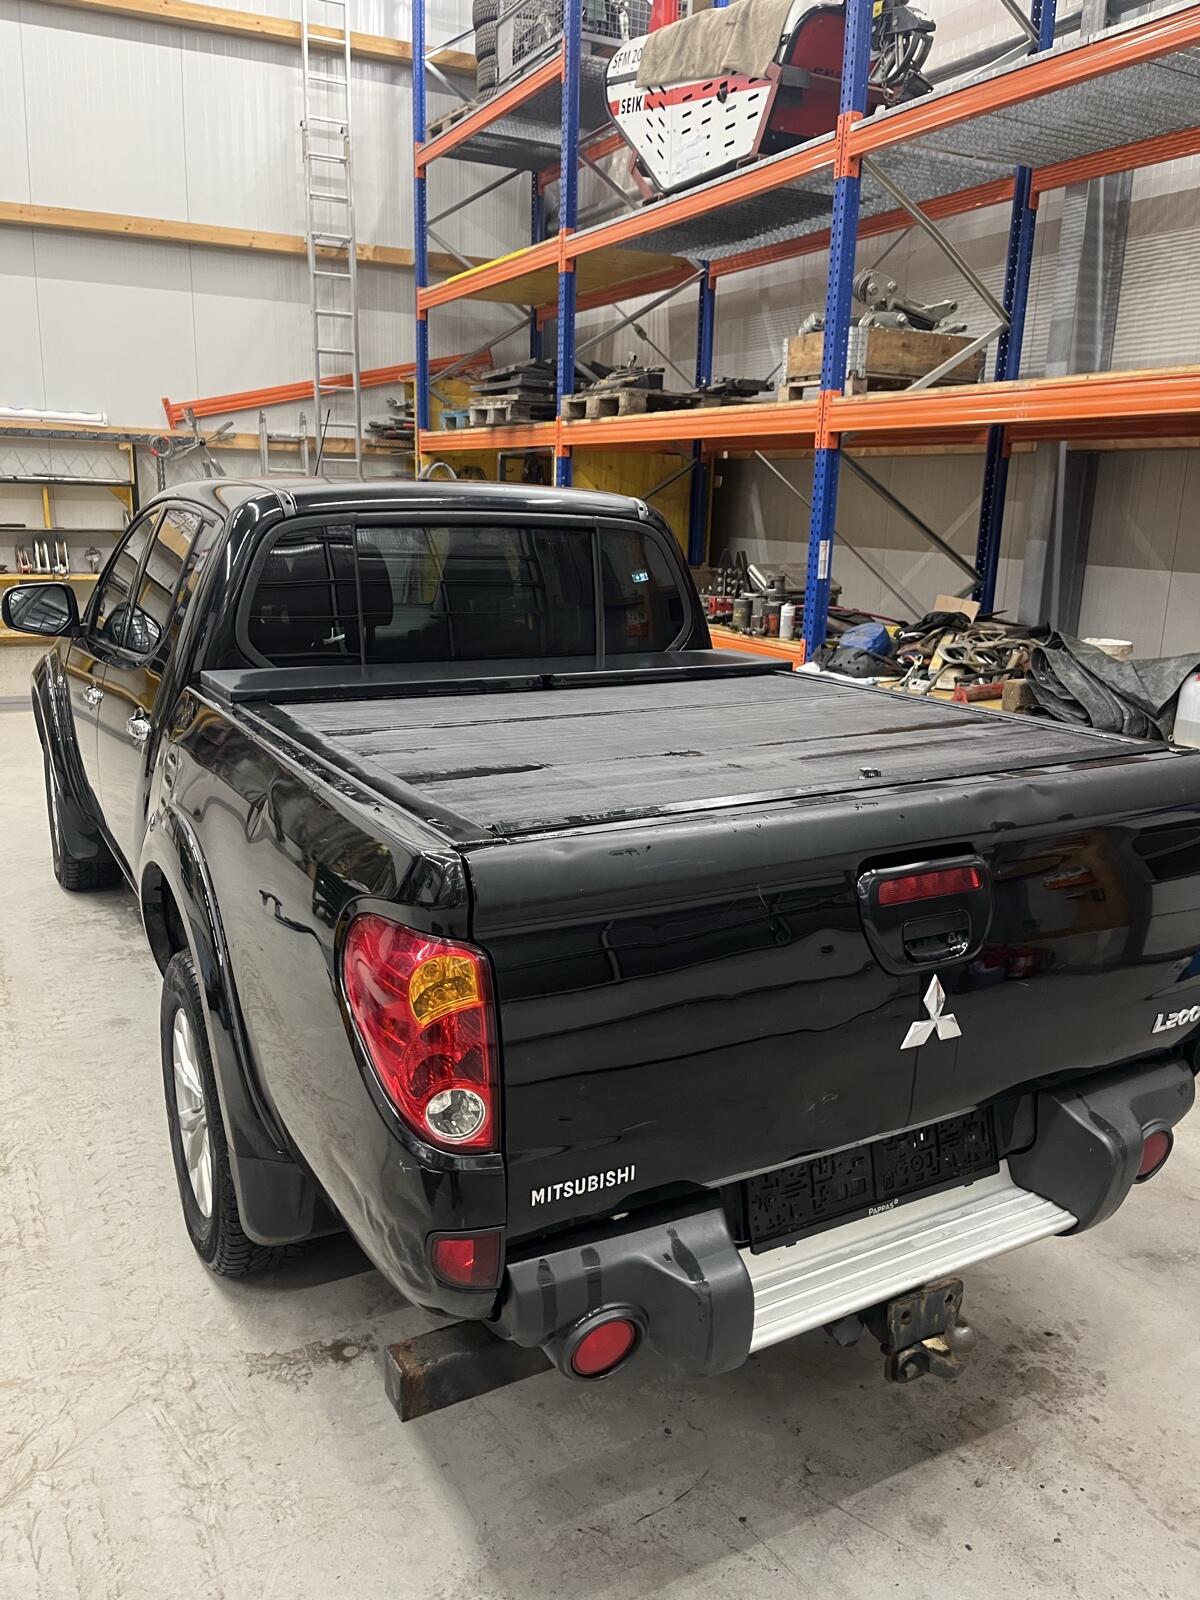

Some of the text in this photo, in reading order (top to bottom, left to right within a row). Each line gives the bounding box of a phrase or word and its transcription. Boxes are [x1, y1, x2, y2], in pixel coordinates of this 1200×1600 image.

[613, 50, 631, 69] SFM
[621, 95, 643, 114] SEIK
[1151, 1005, 1200, 1034] L200
[531, 1165, 635, 1207] MITSUBISHI
[868, 1202, 894, 1216] PAPPAS
